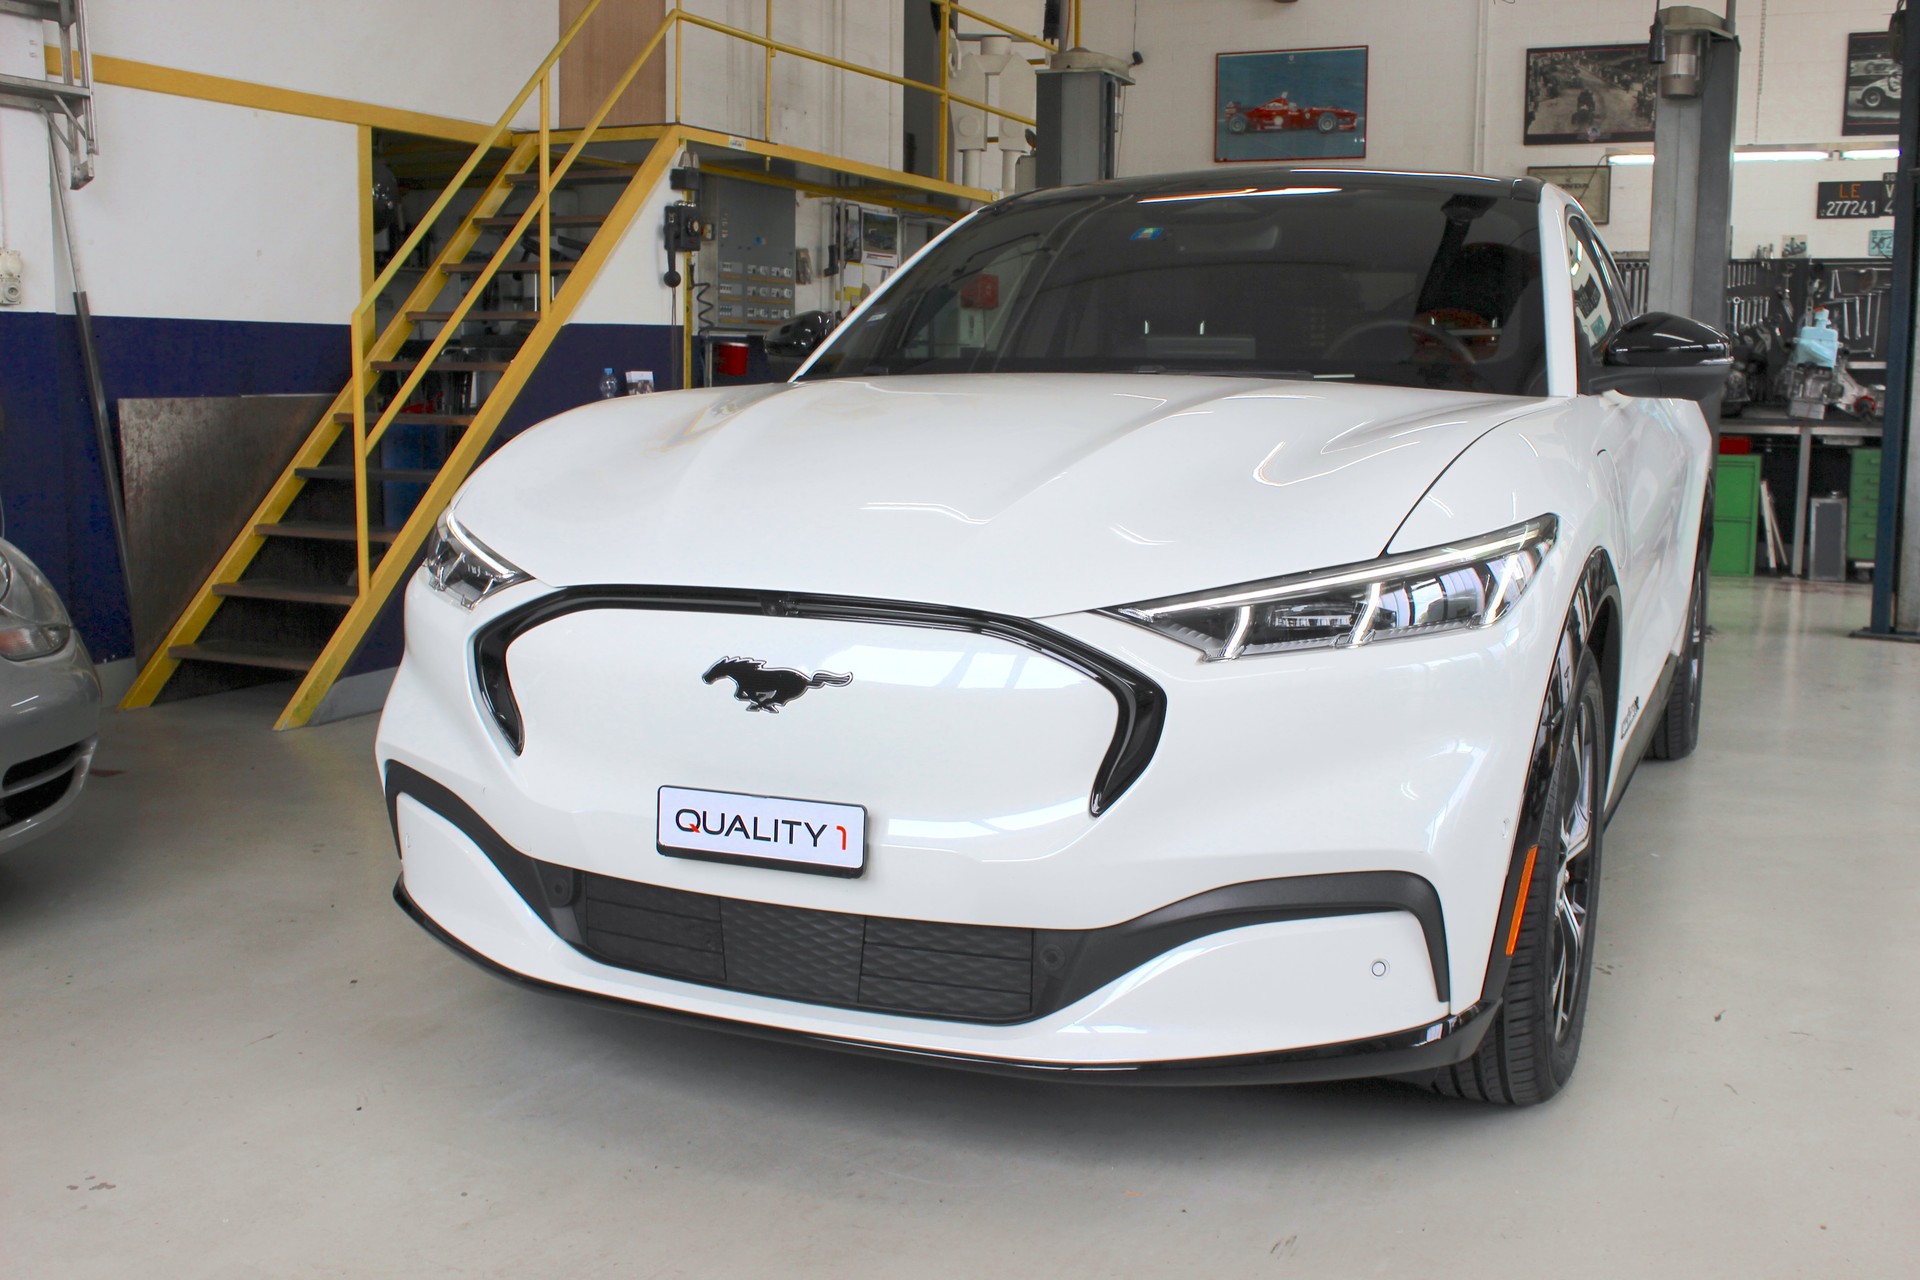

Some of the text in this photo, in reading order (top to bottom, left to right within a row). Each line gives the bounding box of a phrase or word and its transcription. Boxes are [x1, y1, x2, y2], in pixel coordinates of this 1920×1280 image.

[1840, 183, 1861, 198] LE
[1826, 200, 1876, 216] 277241
[675, 808, 847, 851] QUALITY 1
